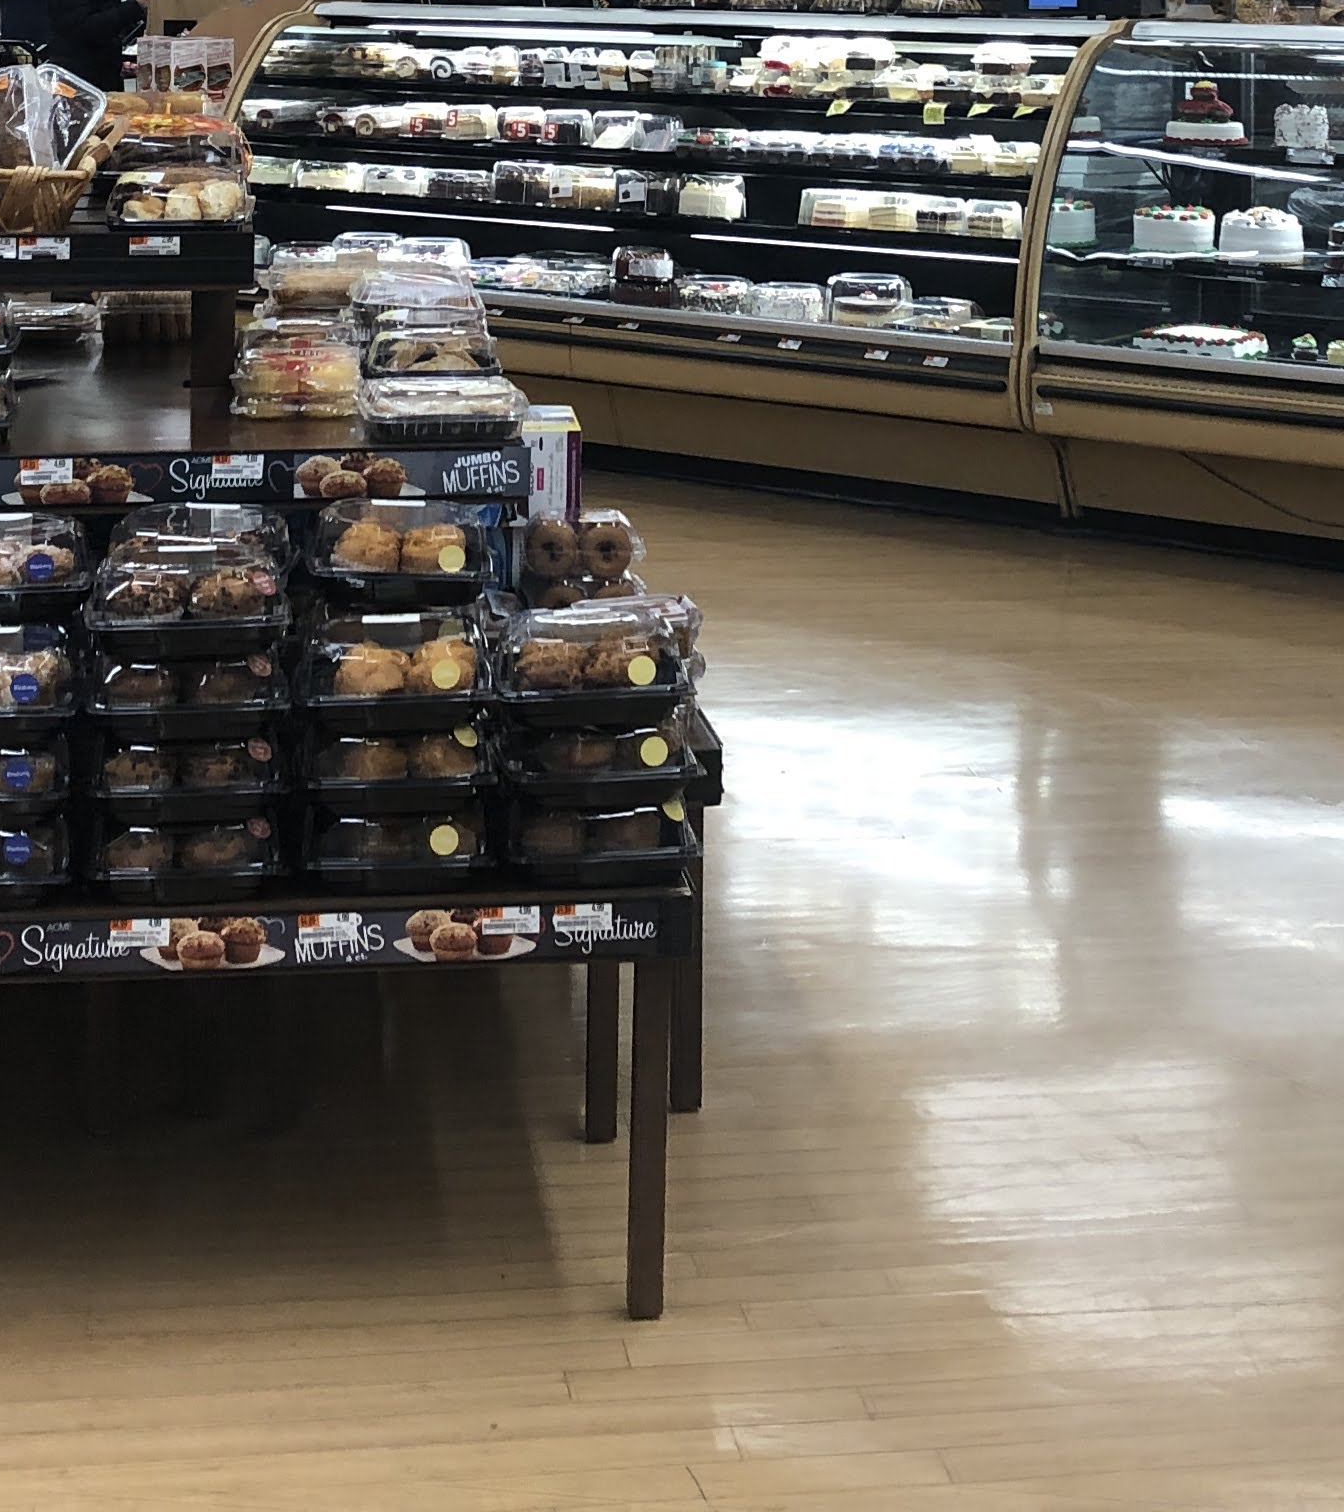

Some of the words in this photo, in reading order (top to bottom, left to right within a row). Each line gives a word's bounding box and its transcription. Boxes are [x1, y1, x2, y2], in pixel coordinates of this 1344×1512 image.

[442, 461, 521, 495] MUFFINS
[453, 451, 501, 468] JUMBO
[21, 924, 131, 971] Signature
[294, 924, 385, 965] MUFFINS
[554, 916, 657, 955] Signature
